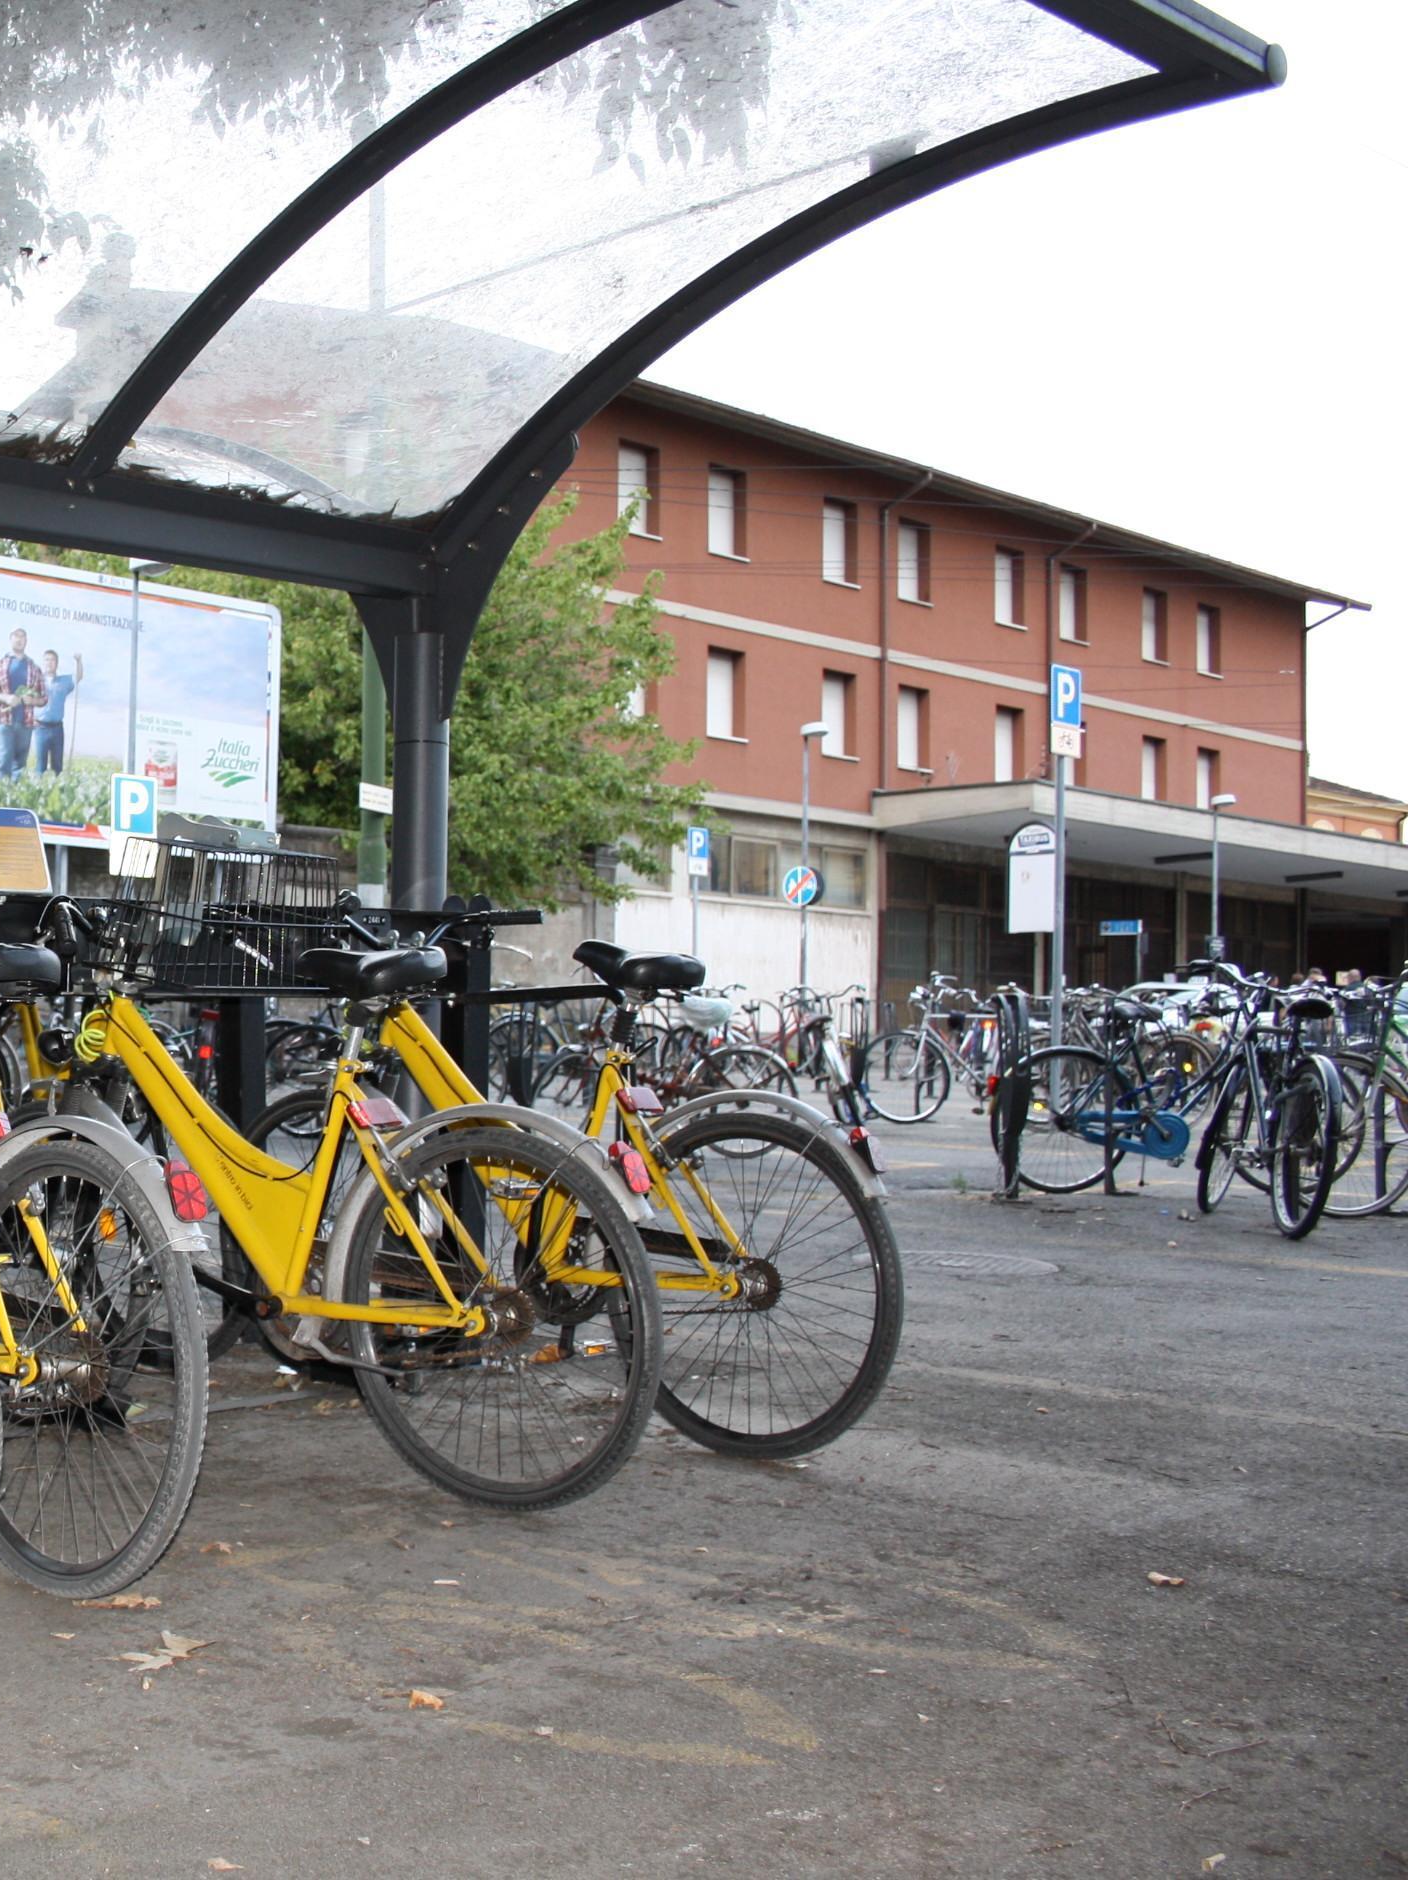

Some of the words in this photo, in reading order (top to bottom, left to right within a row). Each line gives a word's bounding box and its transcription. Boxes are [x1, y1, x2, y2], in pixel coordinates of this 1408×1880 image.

[19, 603, 60, 620] CONSIGLIO
[62, 608, 71, 619] DI
[1057, 672, 1075, 718] P
[218, 736, 251, 757] Italia
[200, 748, 261, 773] Zuccheri
[120, 781, 149, 829] P
[692, 831, 705, 856] P
